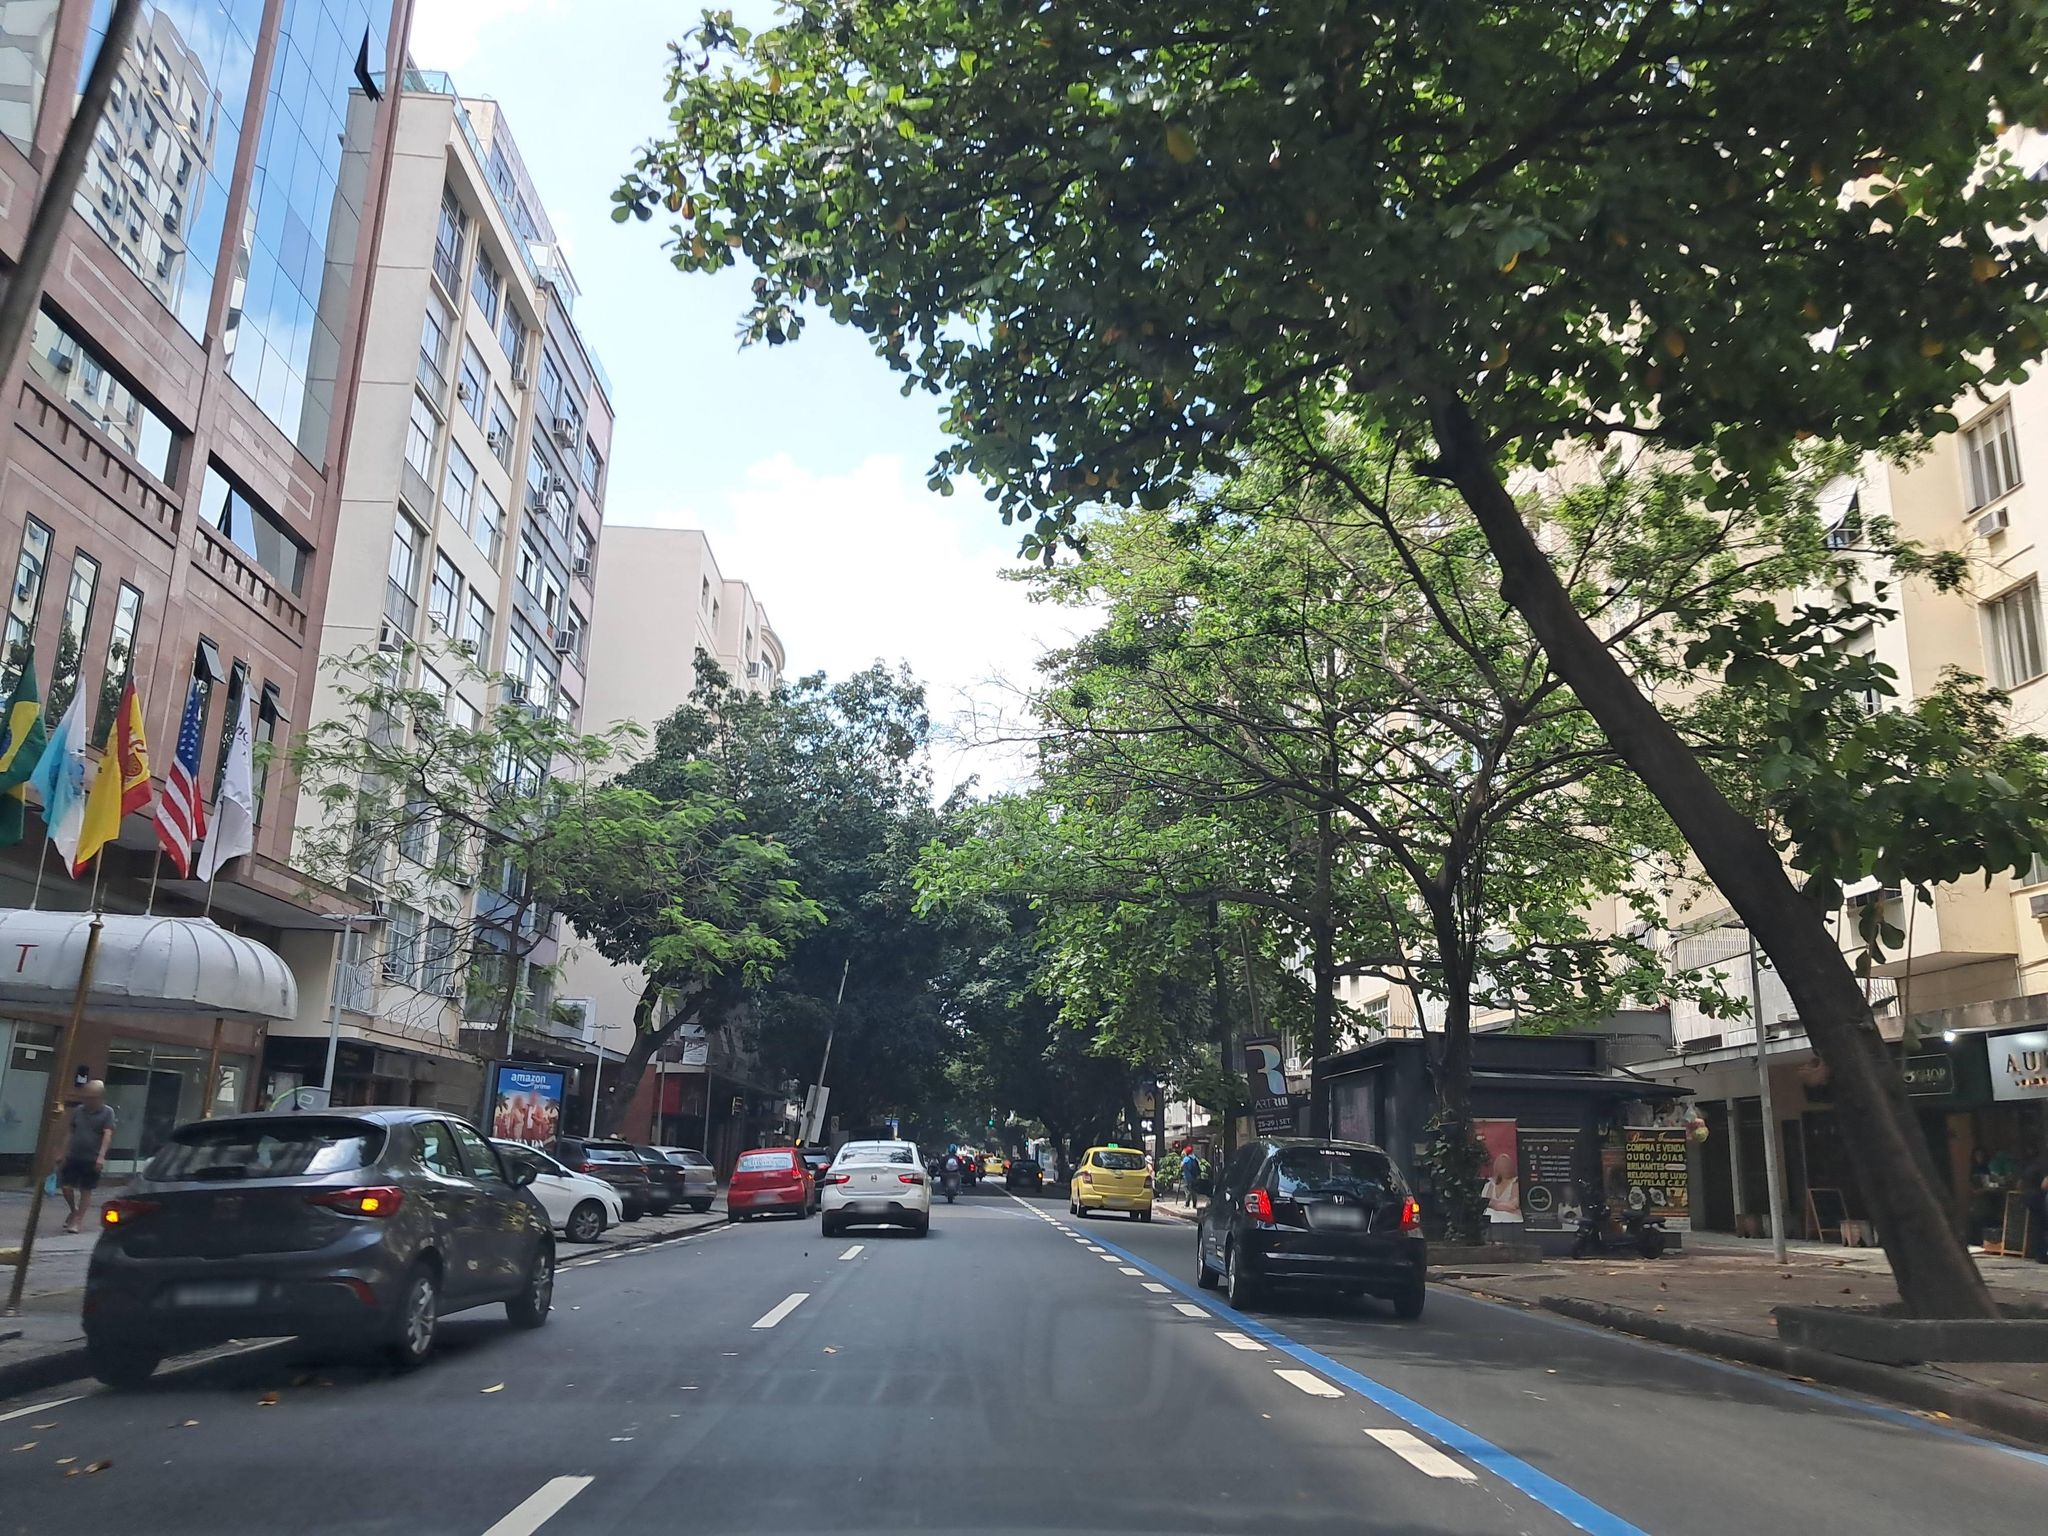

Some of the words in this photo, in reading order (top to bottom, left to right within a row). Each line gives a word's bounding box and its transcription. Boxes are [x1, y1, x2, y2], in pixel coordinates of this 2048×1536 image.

[16, 944, 39, 973] T
[511, 1073, 546, 1083] amazon
[1255, 1096, 1289, 1109] ARTRIO
[1626, 1143, 1656, 1152] COMPRA
[1656, 1143, 1662, 1152] E
[1662, 1143, 1686, 1153] VENDA
[1626, 1161, 1665, 1171] BRILHANTES
[1670, 1172, 1688, 1180] LUXO
